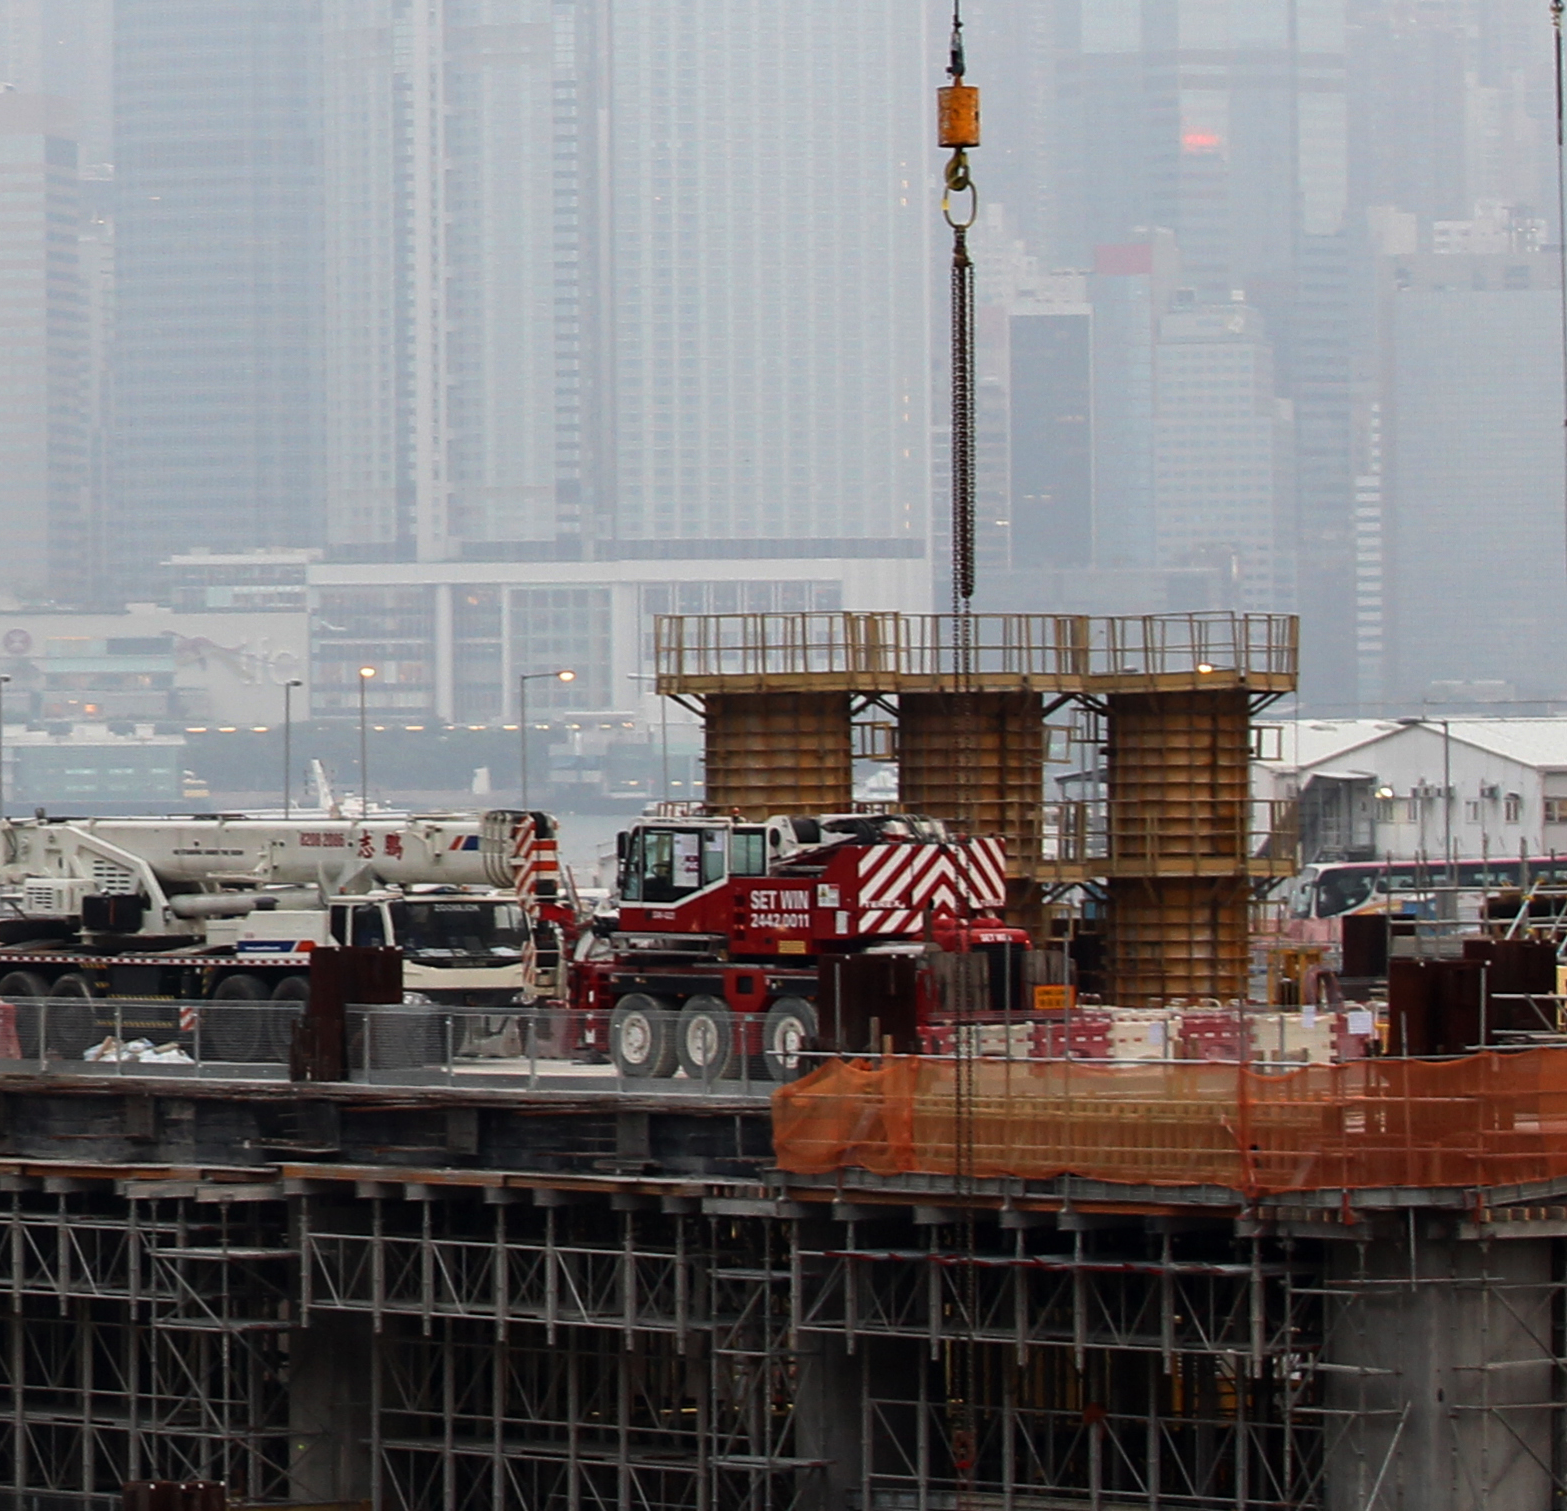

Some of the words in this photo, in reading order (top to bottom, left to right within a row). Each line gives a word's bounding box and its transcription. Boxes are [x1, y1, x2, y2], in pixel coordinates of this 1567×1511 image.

[750, 890, 777, 910] SET
[780, 890, 809, 910] WIN
[750, 913, 781, 928] 2442
[783, 913, 810, 928] 0011
